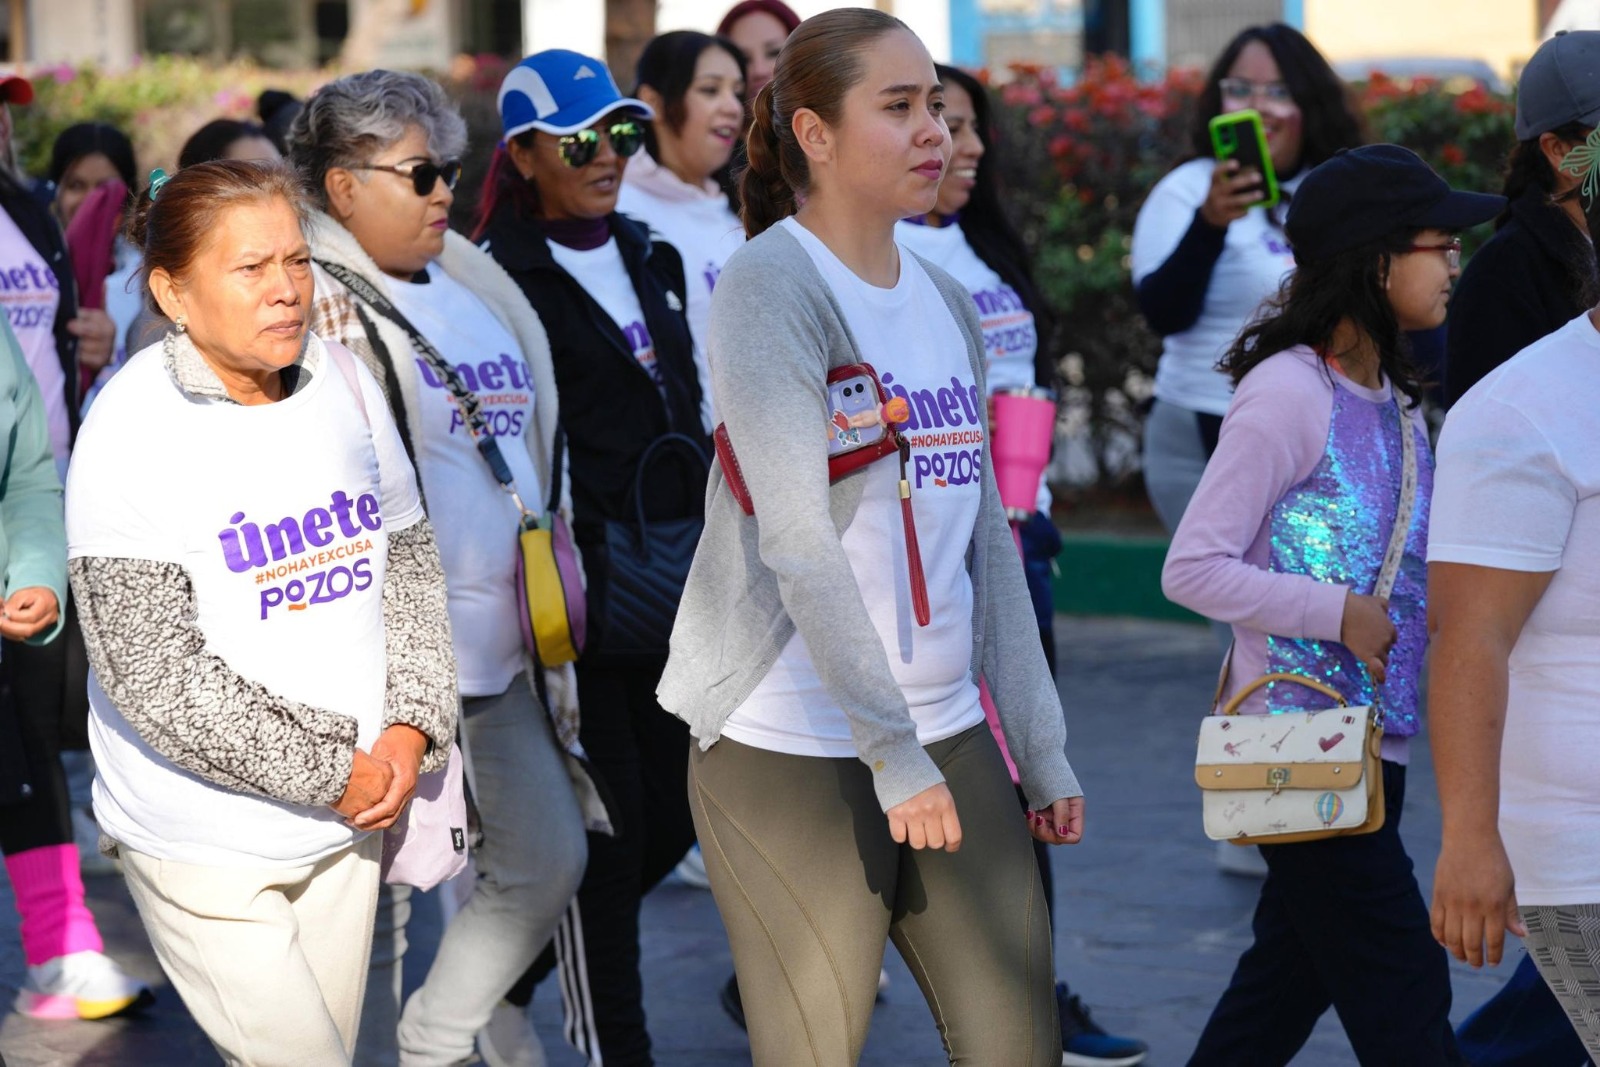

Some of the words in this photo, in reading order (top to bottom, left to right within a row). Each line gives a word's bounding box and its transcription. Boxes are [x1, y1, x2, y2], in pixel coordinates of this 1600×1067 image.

[449, 408, 524, 437] PZOS
[218, 490, 382, 573] únete
[254, 539, 374, 585] #NOHAYEXCUSA
